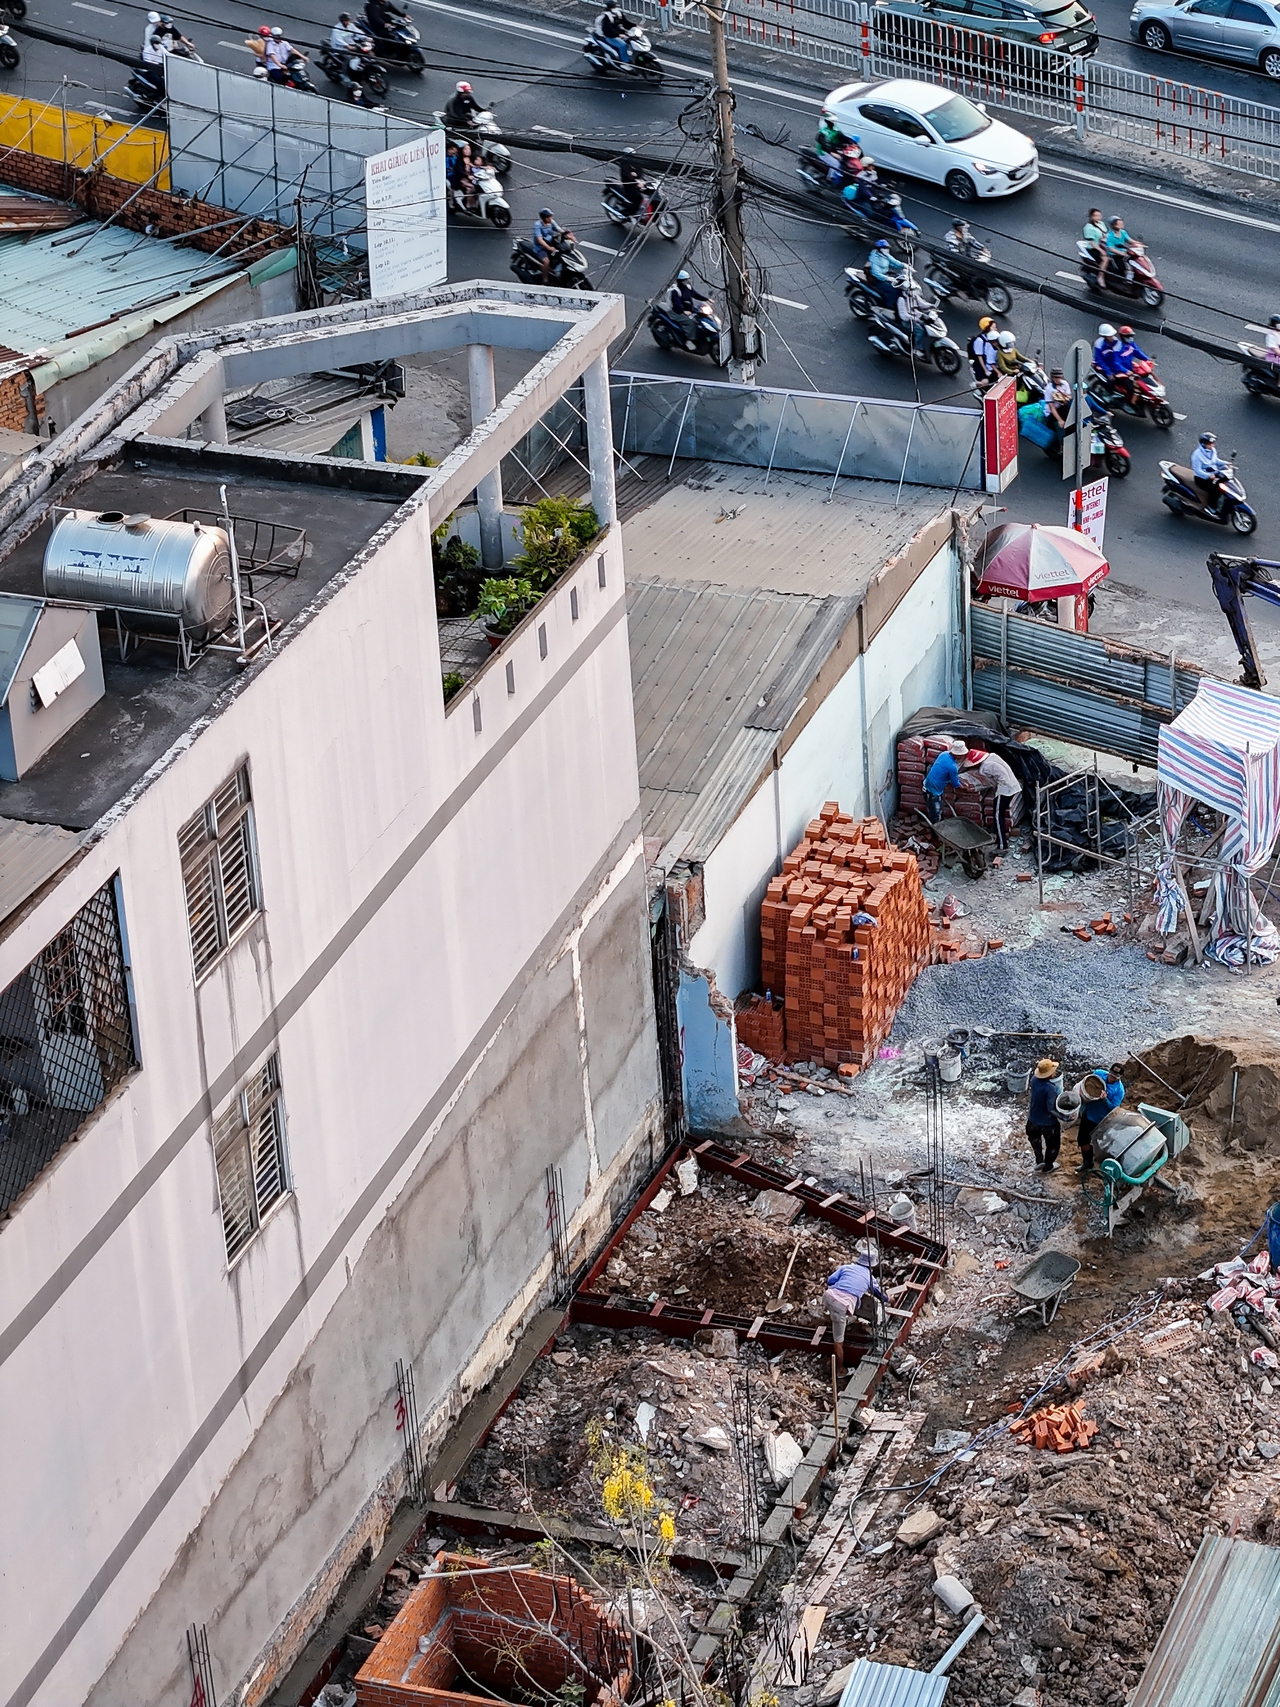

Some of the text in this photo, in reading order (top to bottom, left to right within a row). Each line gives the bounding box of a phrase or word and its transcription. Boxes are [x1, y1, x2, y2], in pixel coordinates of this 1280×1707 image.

[1072, 482, 1106, 506] vettel
[1034, 569, 1070, 580] viettel
[988, 585, 1020, 598] viettel
